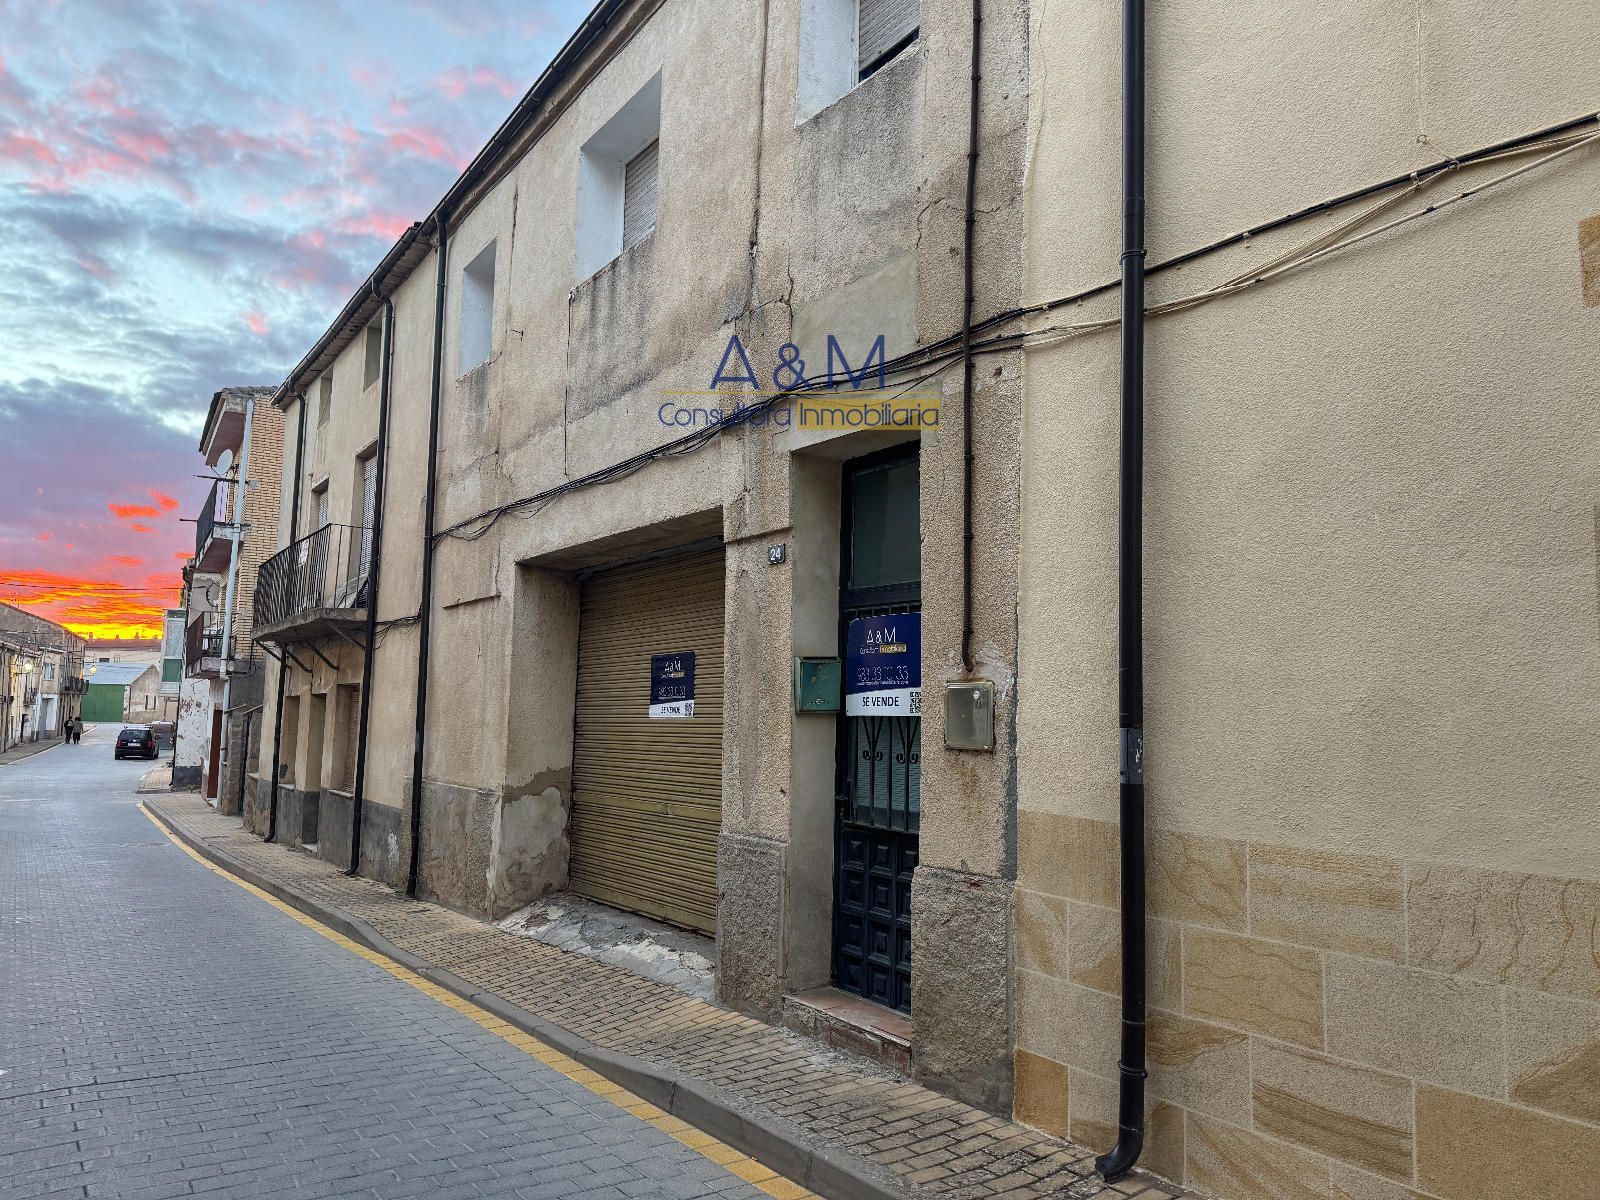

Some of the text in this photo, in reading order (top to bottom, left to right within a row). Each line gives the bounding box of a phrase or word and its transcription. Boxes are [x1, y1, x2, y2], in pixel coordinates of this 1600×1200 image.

[770, 547, 781, 560] 24
[862, 696, 900, 707] SE VENDE
